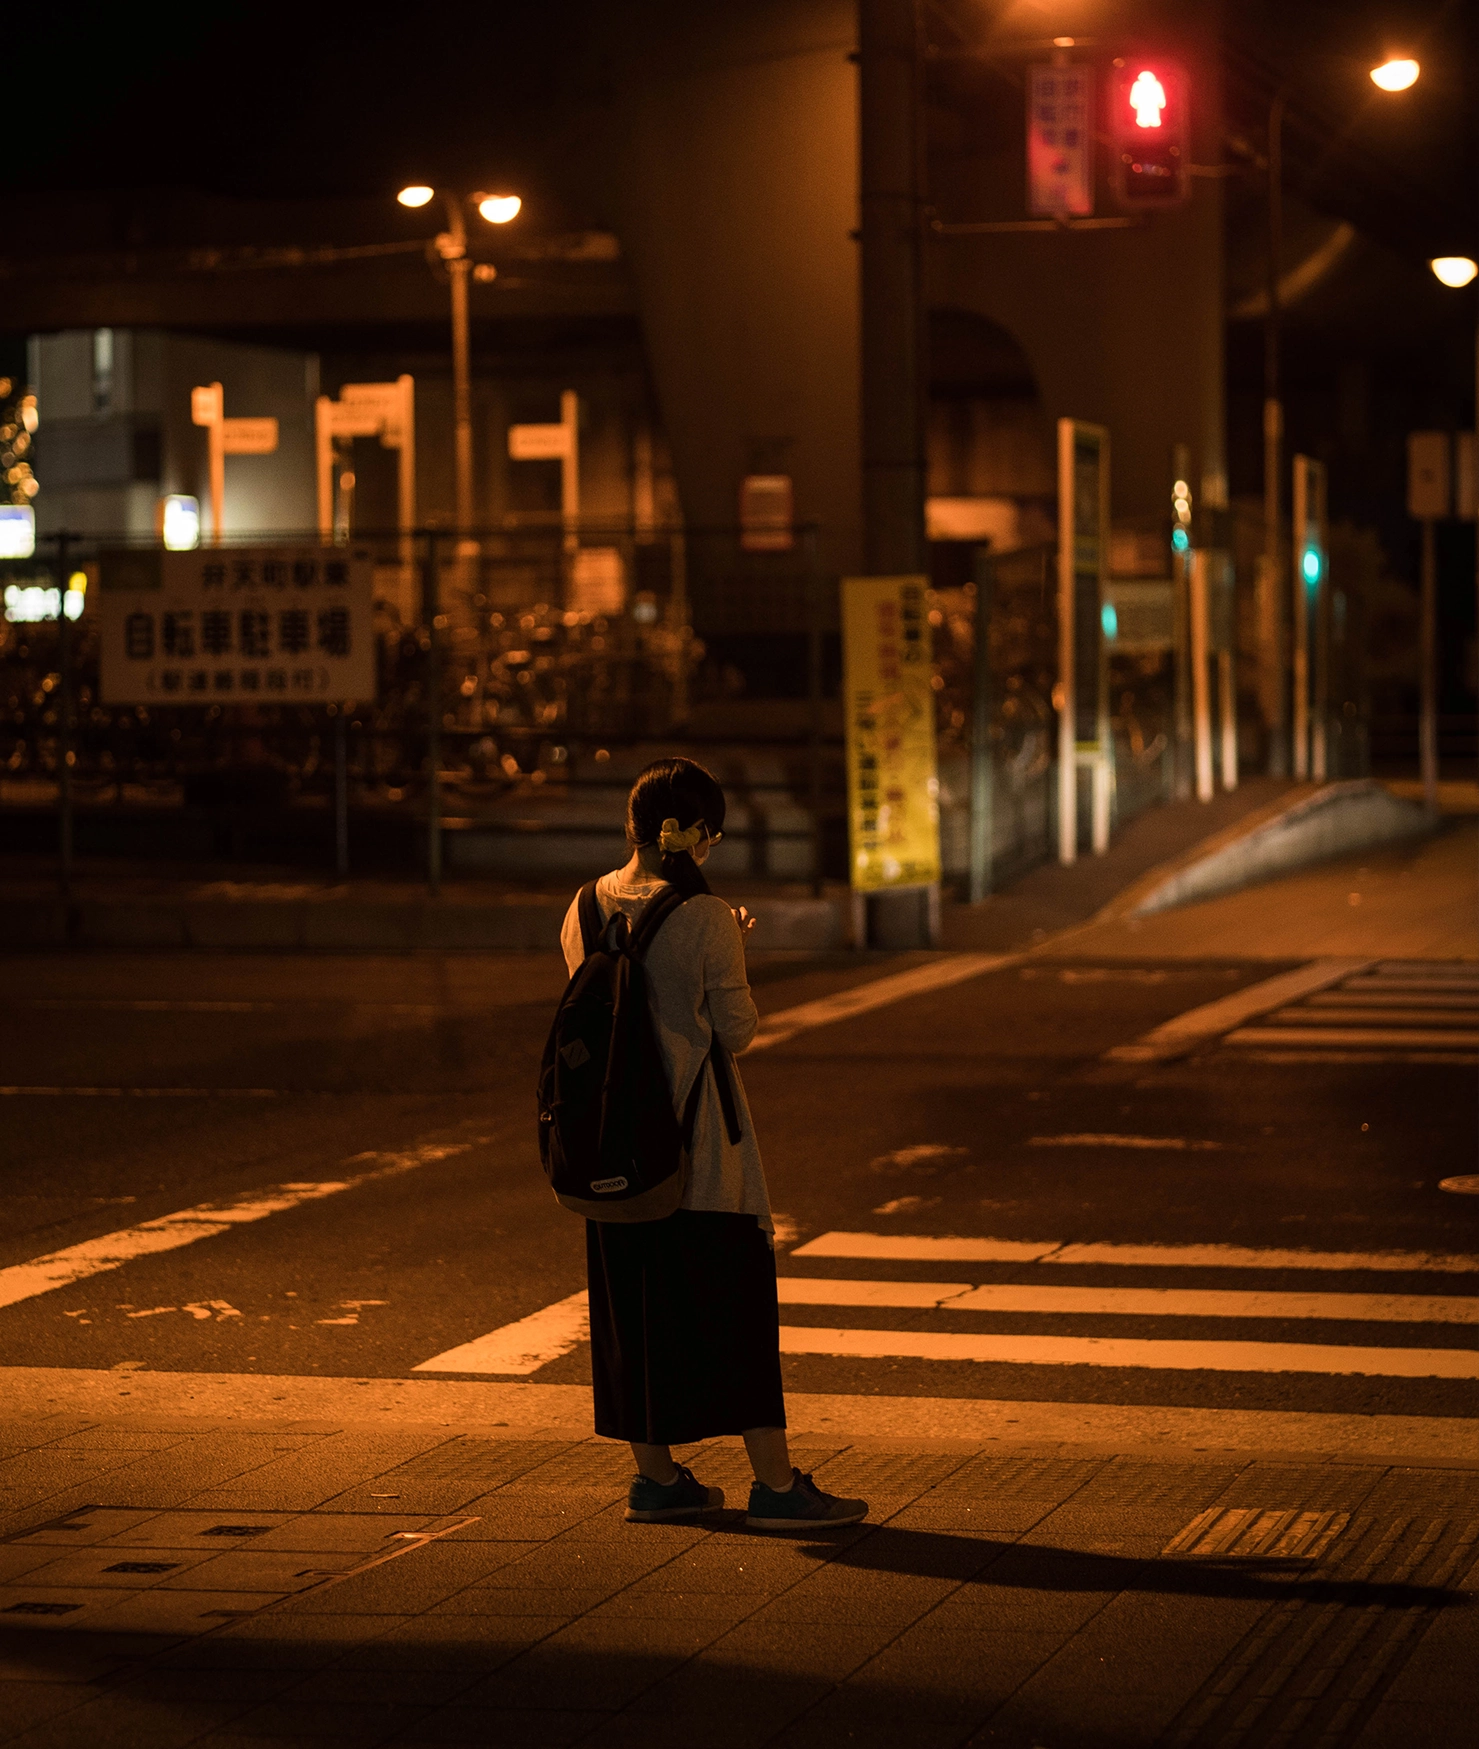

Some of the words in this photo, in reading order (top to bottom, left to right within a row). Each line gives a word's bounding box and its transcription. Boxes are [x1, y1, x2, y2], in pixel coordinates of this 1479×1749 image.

[127, 608, 351, 658] 自転車駐車場
